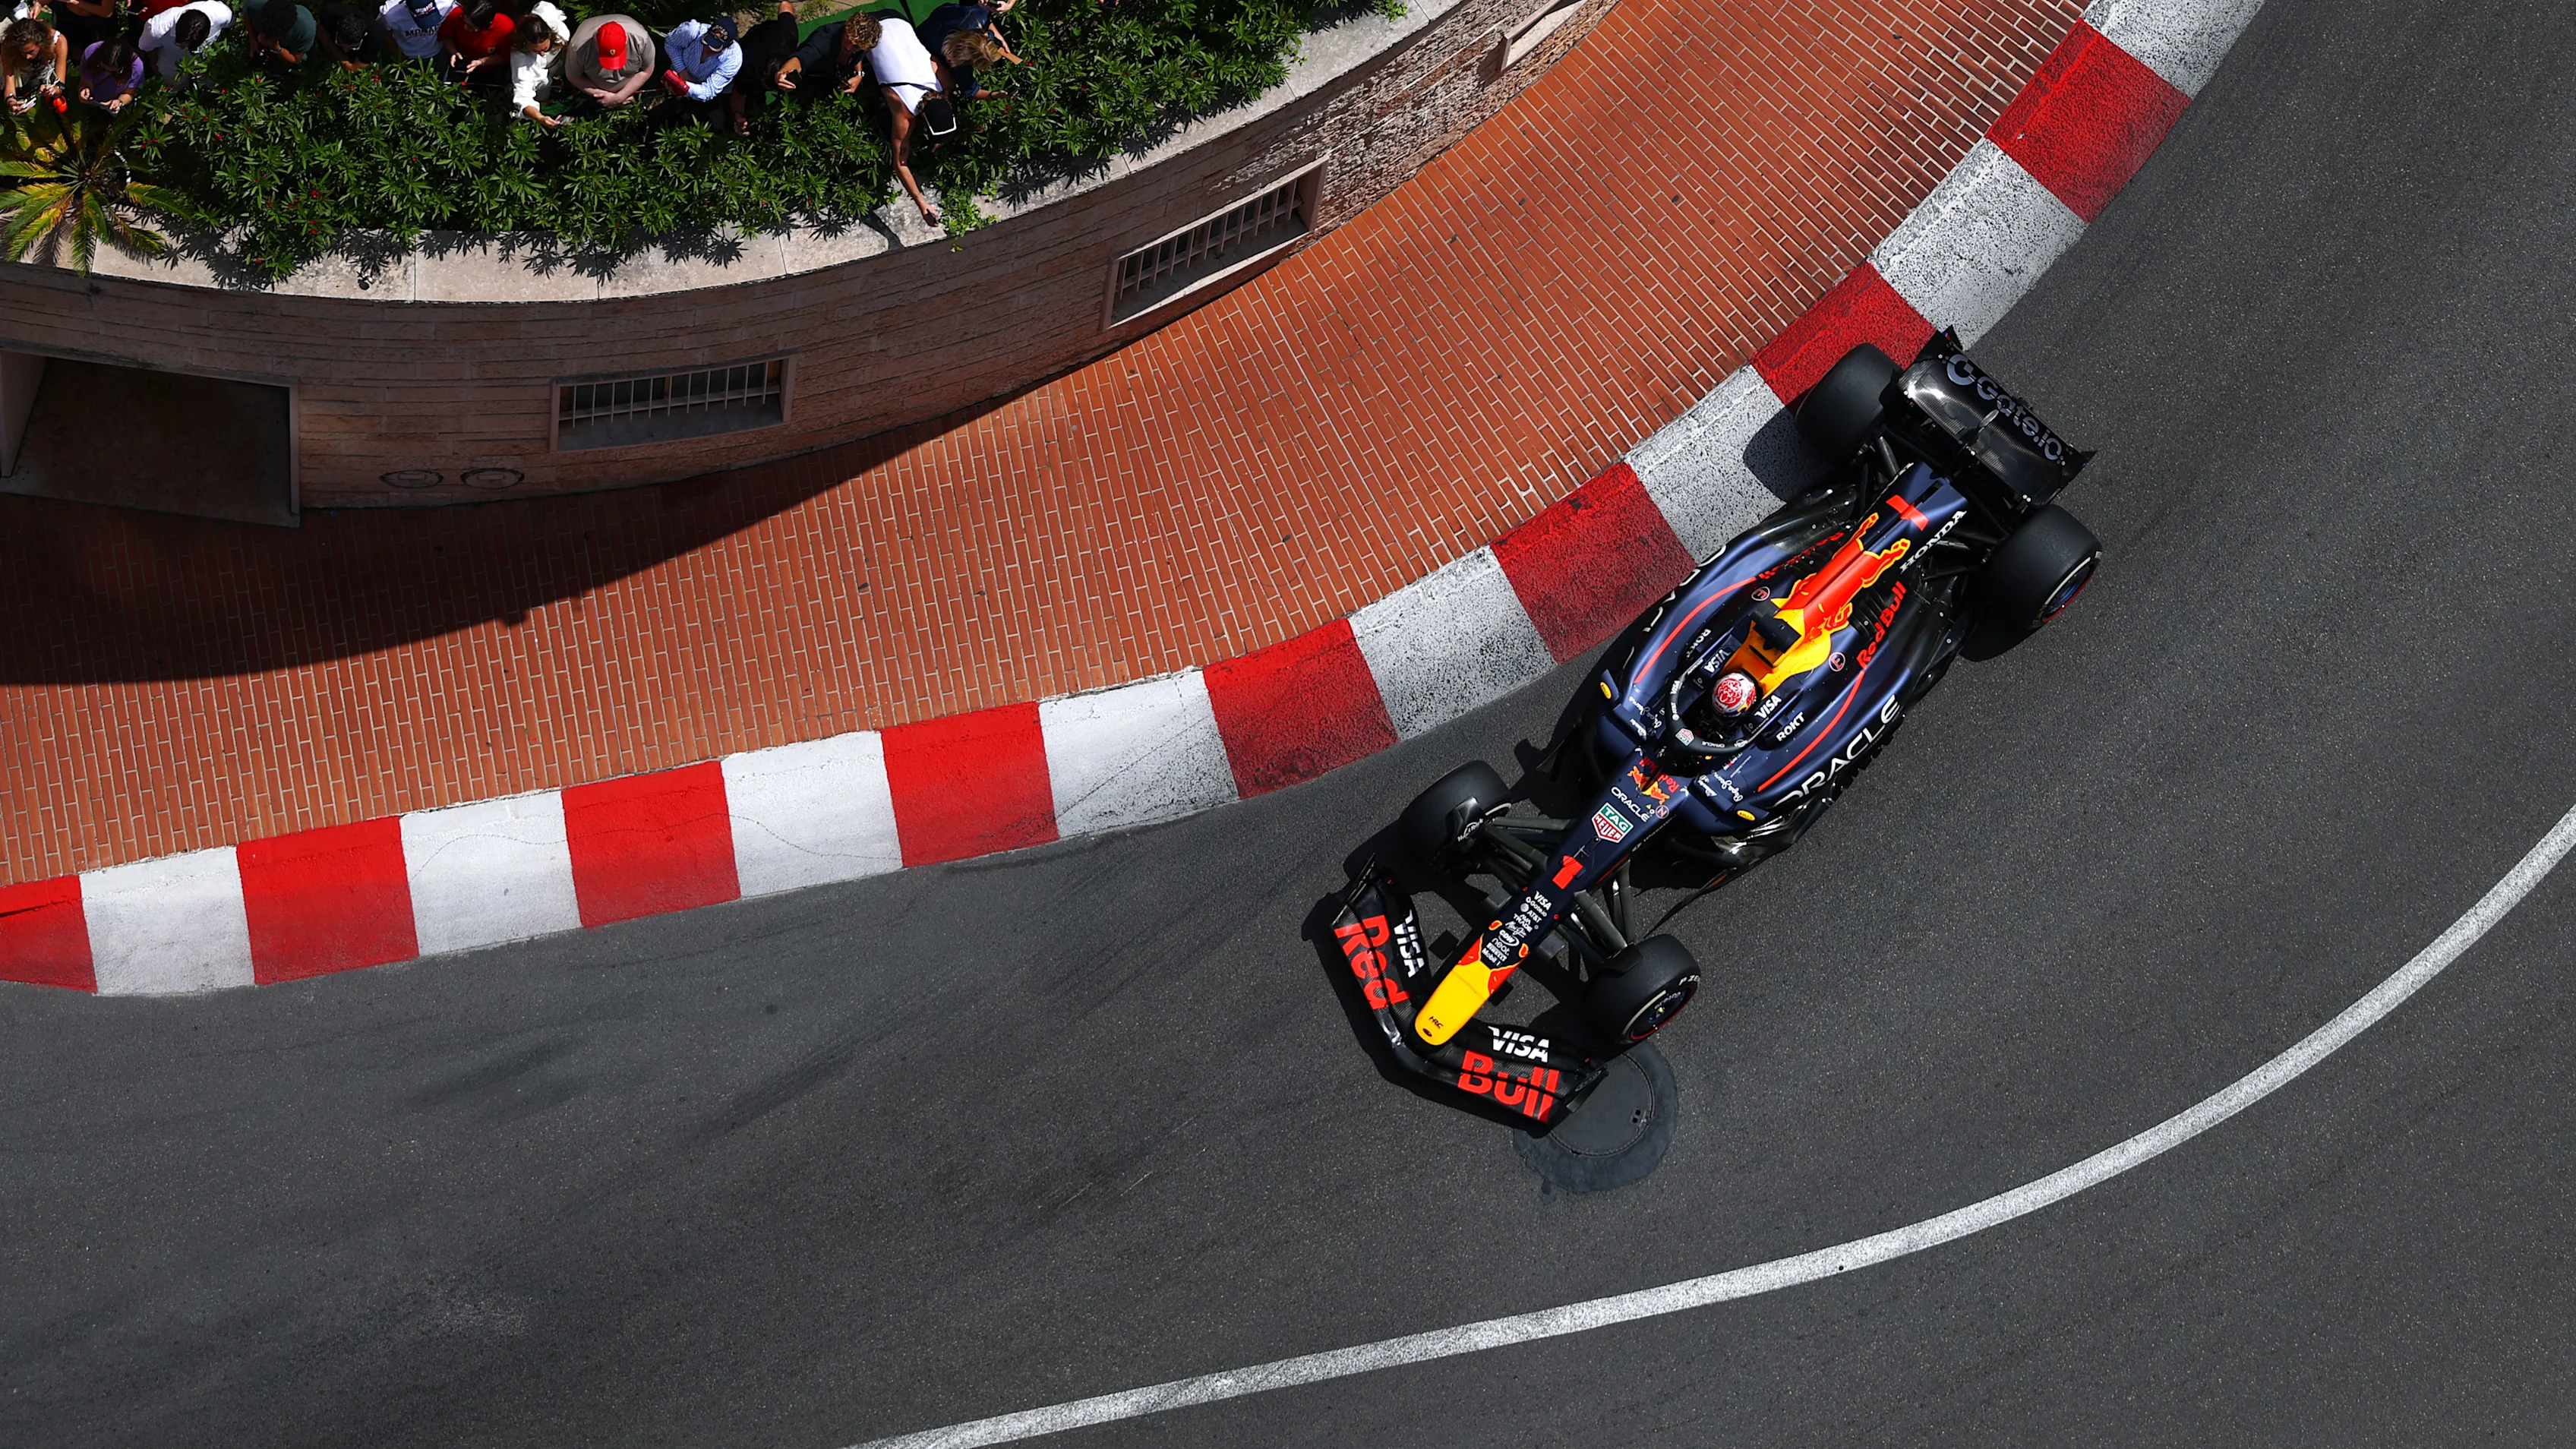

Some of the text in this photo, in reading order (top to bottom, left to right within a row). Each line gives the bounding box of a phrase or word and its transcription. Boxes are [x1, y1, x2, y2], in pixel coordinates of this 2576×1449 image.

[1977, 376, 2063, 461] Gate.io
[1885, 494, 1930, 532] 1
[1899, 510, 1967, 575] HONDA
[1856, 581, 1907, 670] Red Bull
[1703, 649, 1732, 674] VISA
[1670, 680, 1681, 695] VISA
[1754, 695, 1782, 719] VISA
[1776, 712, 1805, 742] ROKT
[1658, 773, 1681, 793] Red
[1611, 786, 1650, 822] ORACLE
[1595, 814, 1622, 841] HEUER
[1605, 807, 1629, 832] TAG
[1552, 855, 1583, 890] 1
[1530, 901, 1548, 917] Gate.io
[1534, 890, 1552, 911] VISA
[1514, 913, 1533, 933] TRADE
[1520, 914, 1531, 925] AVA
[1526, 910, 1542, 923] AT&T
[1394, 908, 1425, 978] VISA
[1492, 937, 1511, 956] neat.
[1499, 929, 1515, 943] CDW
[1334, 914, 1411, 1010] Red
[1482, 948, 1498, 964] Mobil
[1678, 977, 1687, 986] P
[1428, 1015, 1444, 1030] HRC
[1488, 1026, 1549, 1063] VISA
[1457, 1050, 1559, 1123] Bull
